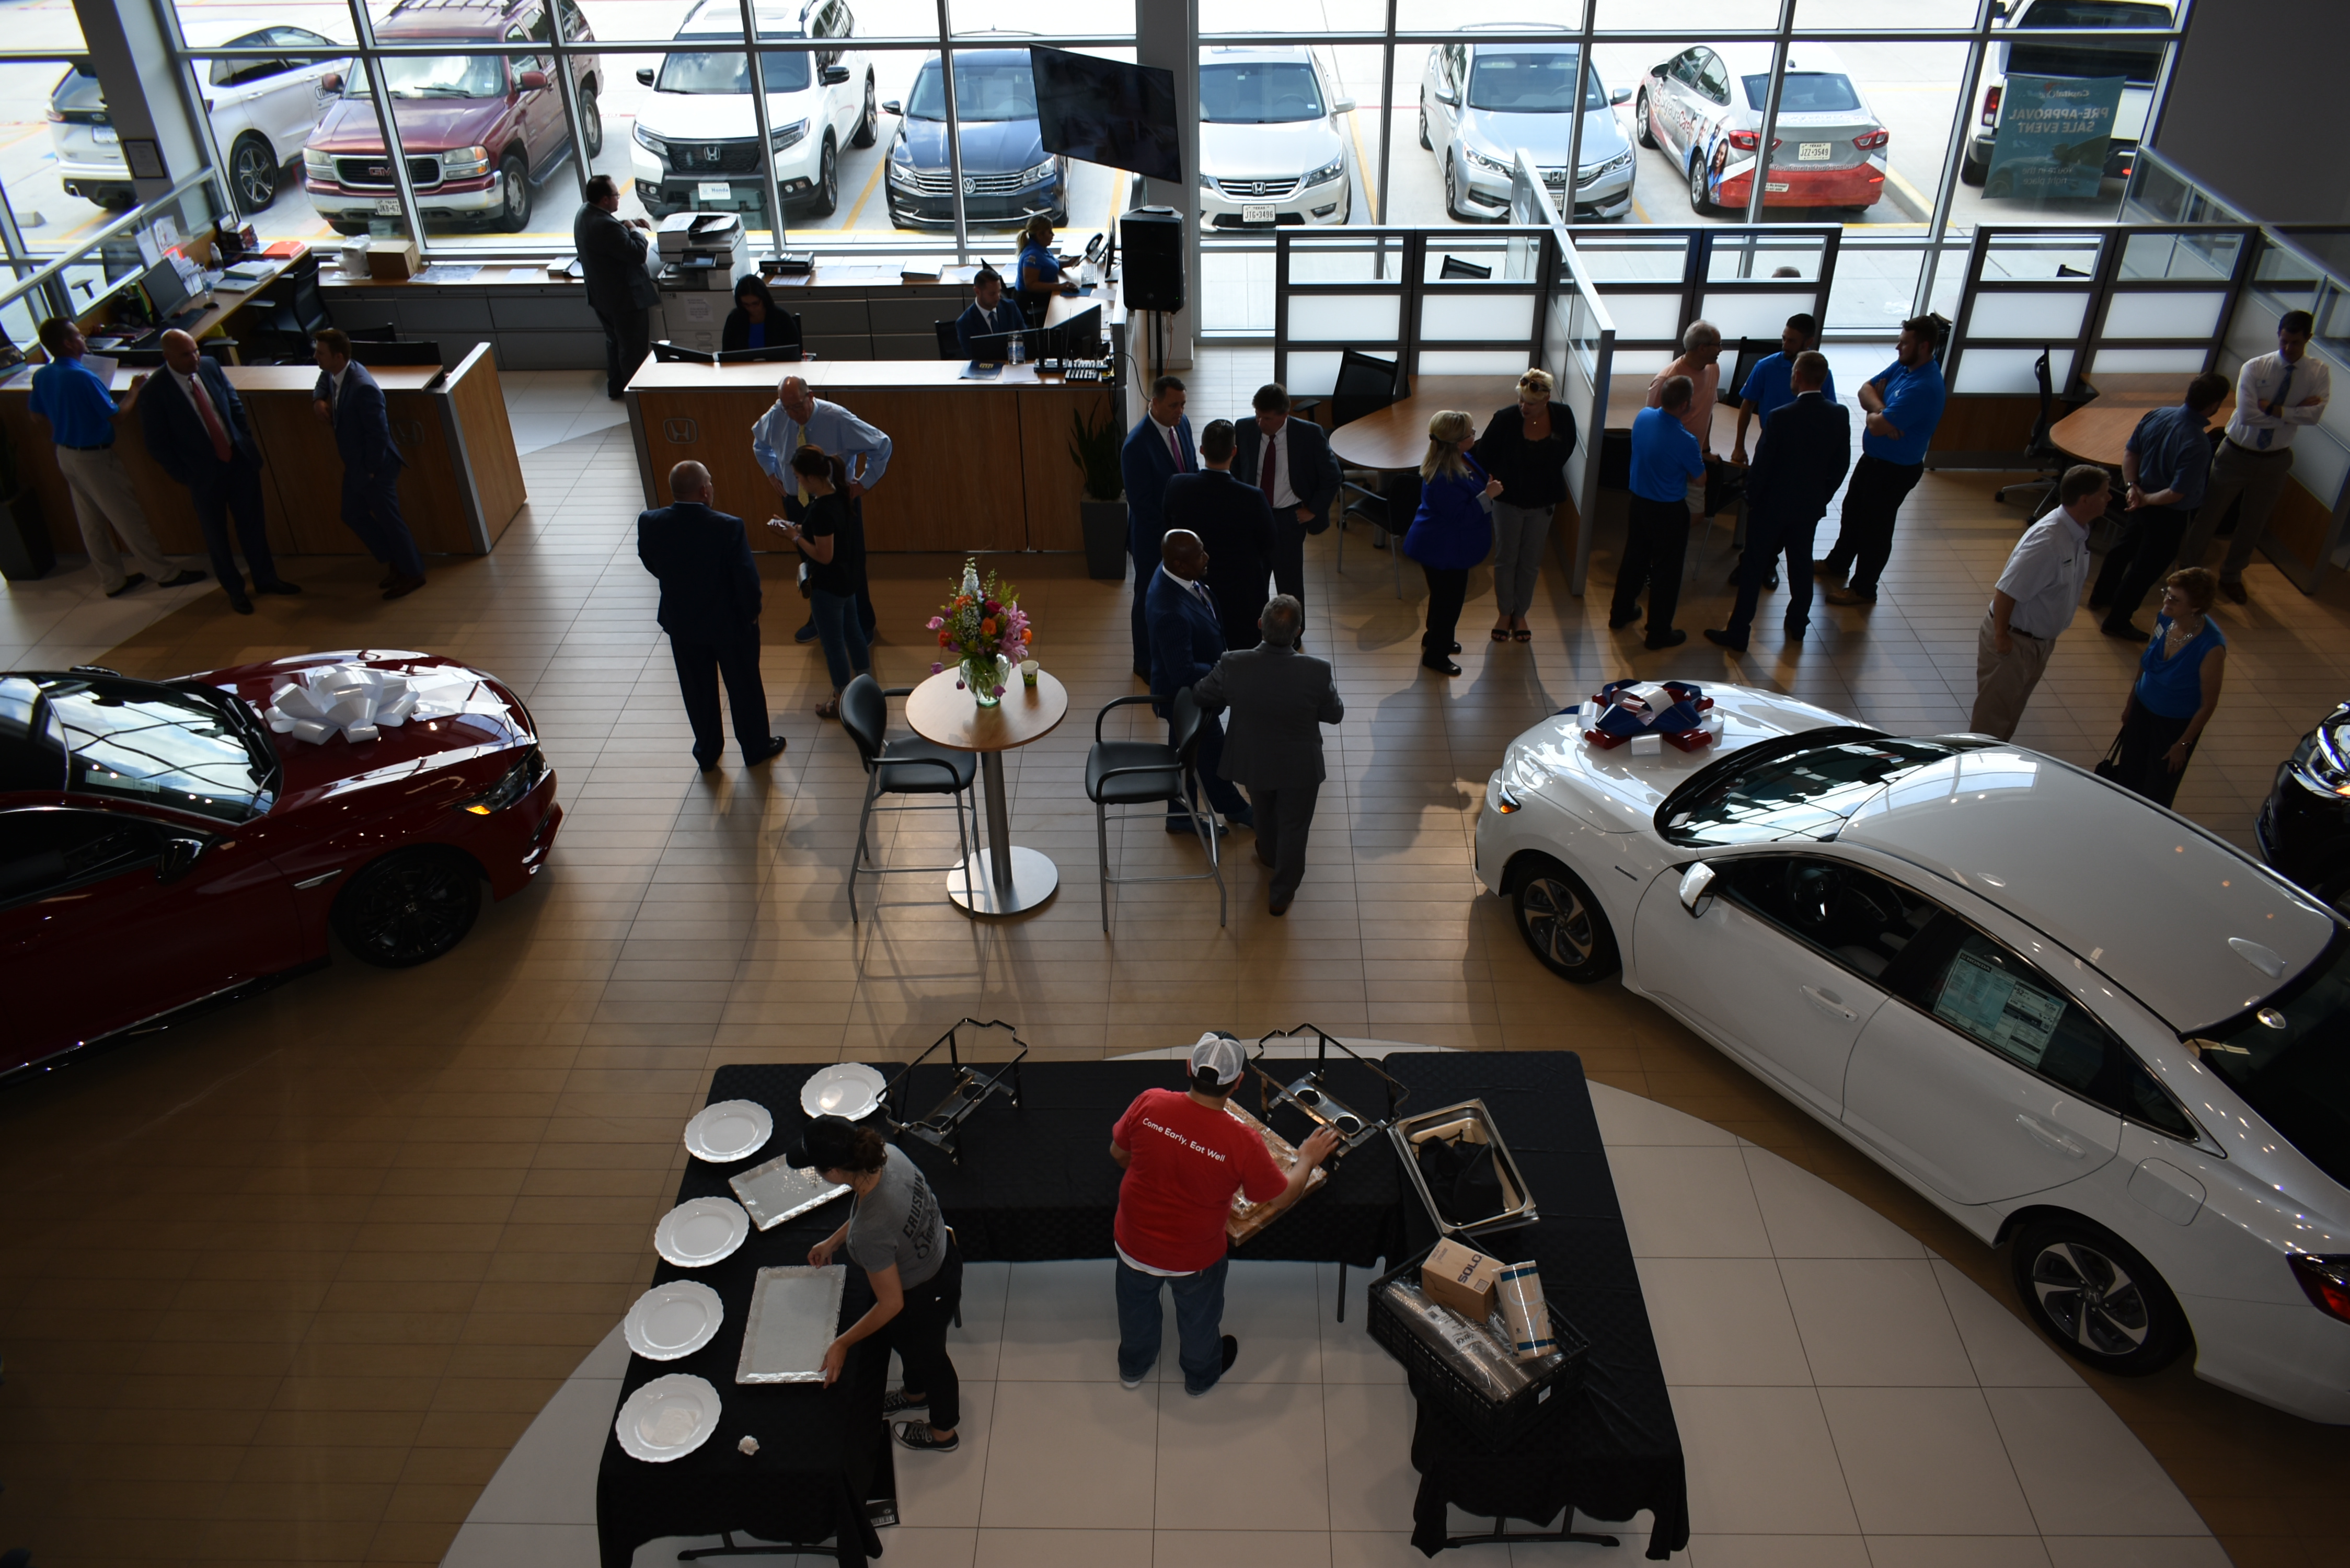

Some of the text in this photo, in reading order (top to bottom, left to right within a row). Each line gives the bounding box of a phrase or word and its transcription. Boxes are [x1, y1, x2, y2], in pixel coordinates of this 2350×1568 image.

[369, 167, 391, 176] GM
[1966, 956, 1990, 971] HONDA
[1143, 1117, 1164, 1133] Come
[1190, 1140, 1205, 1154] Eat
[1207, 1148, 1226, 1162] Well
[1457, 1253, 1482, 1283] SOLO
